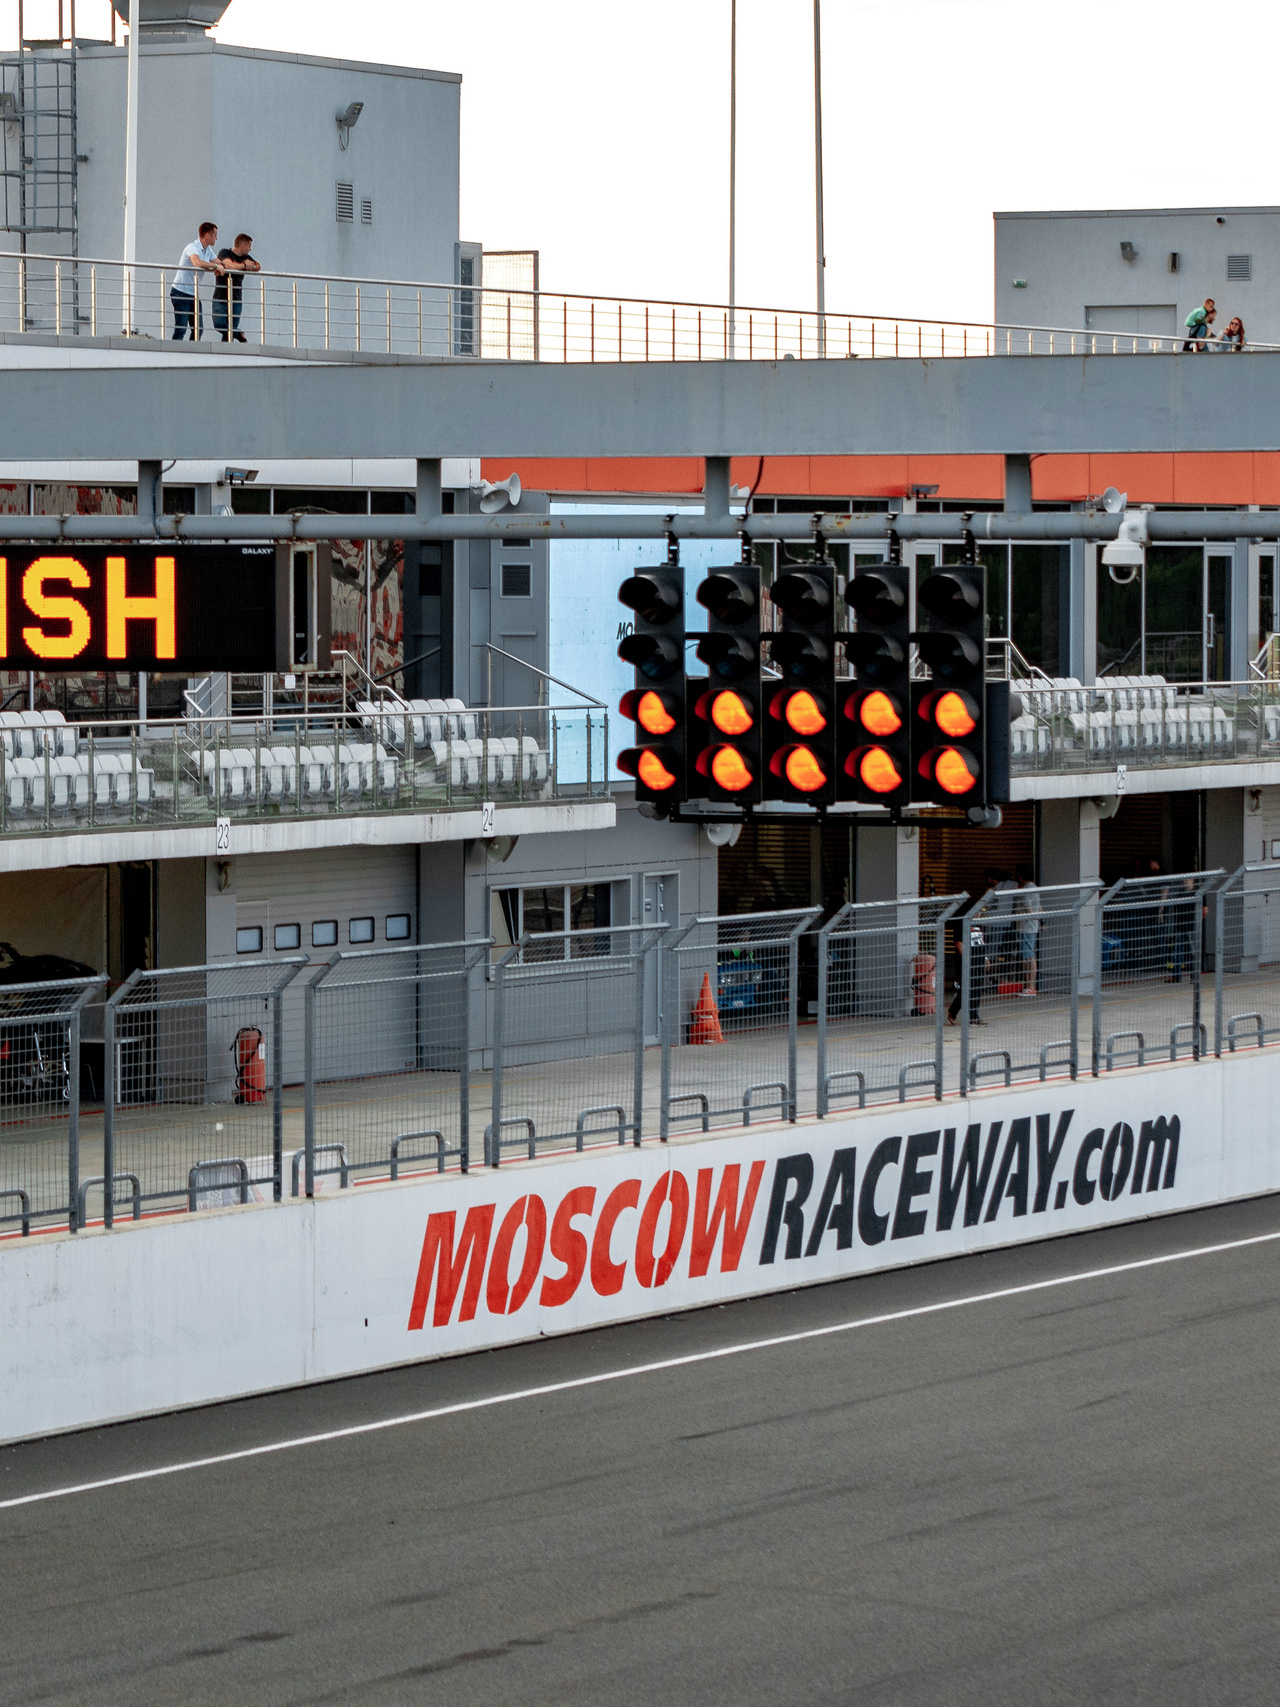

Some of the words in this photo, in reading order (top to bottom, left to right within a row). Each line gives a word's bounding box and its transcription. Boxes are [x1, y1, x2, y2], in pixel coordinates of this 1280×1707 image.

[241, 547, 271, 555] GALAXY
[483, 807, 494, 832] 24
[217, 823, 230, 850] 23
